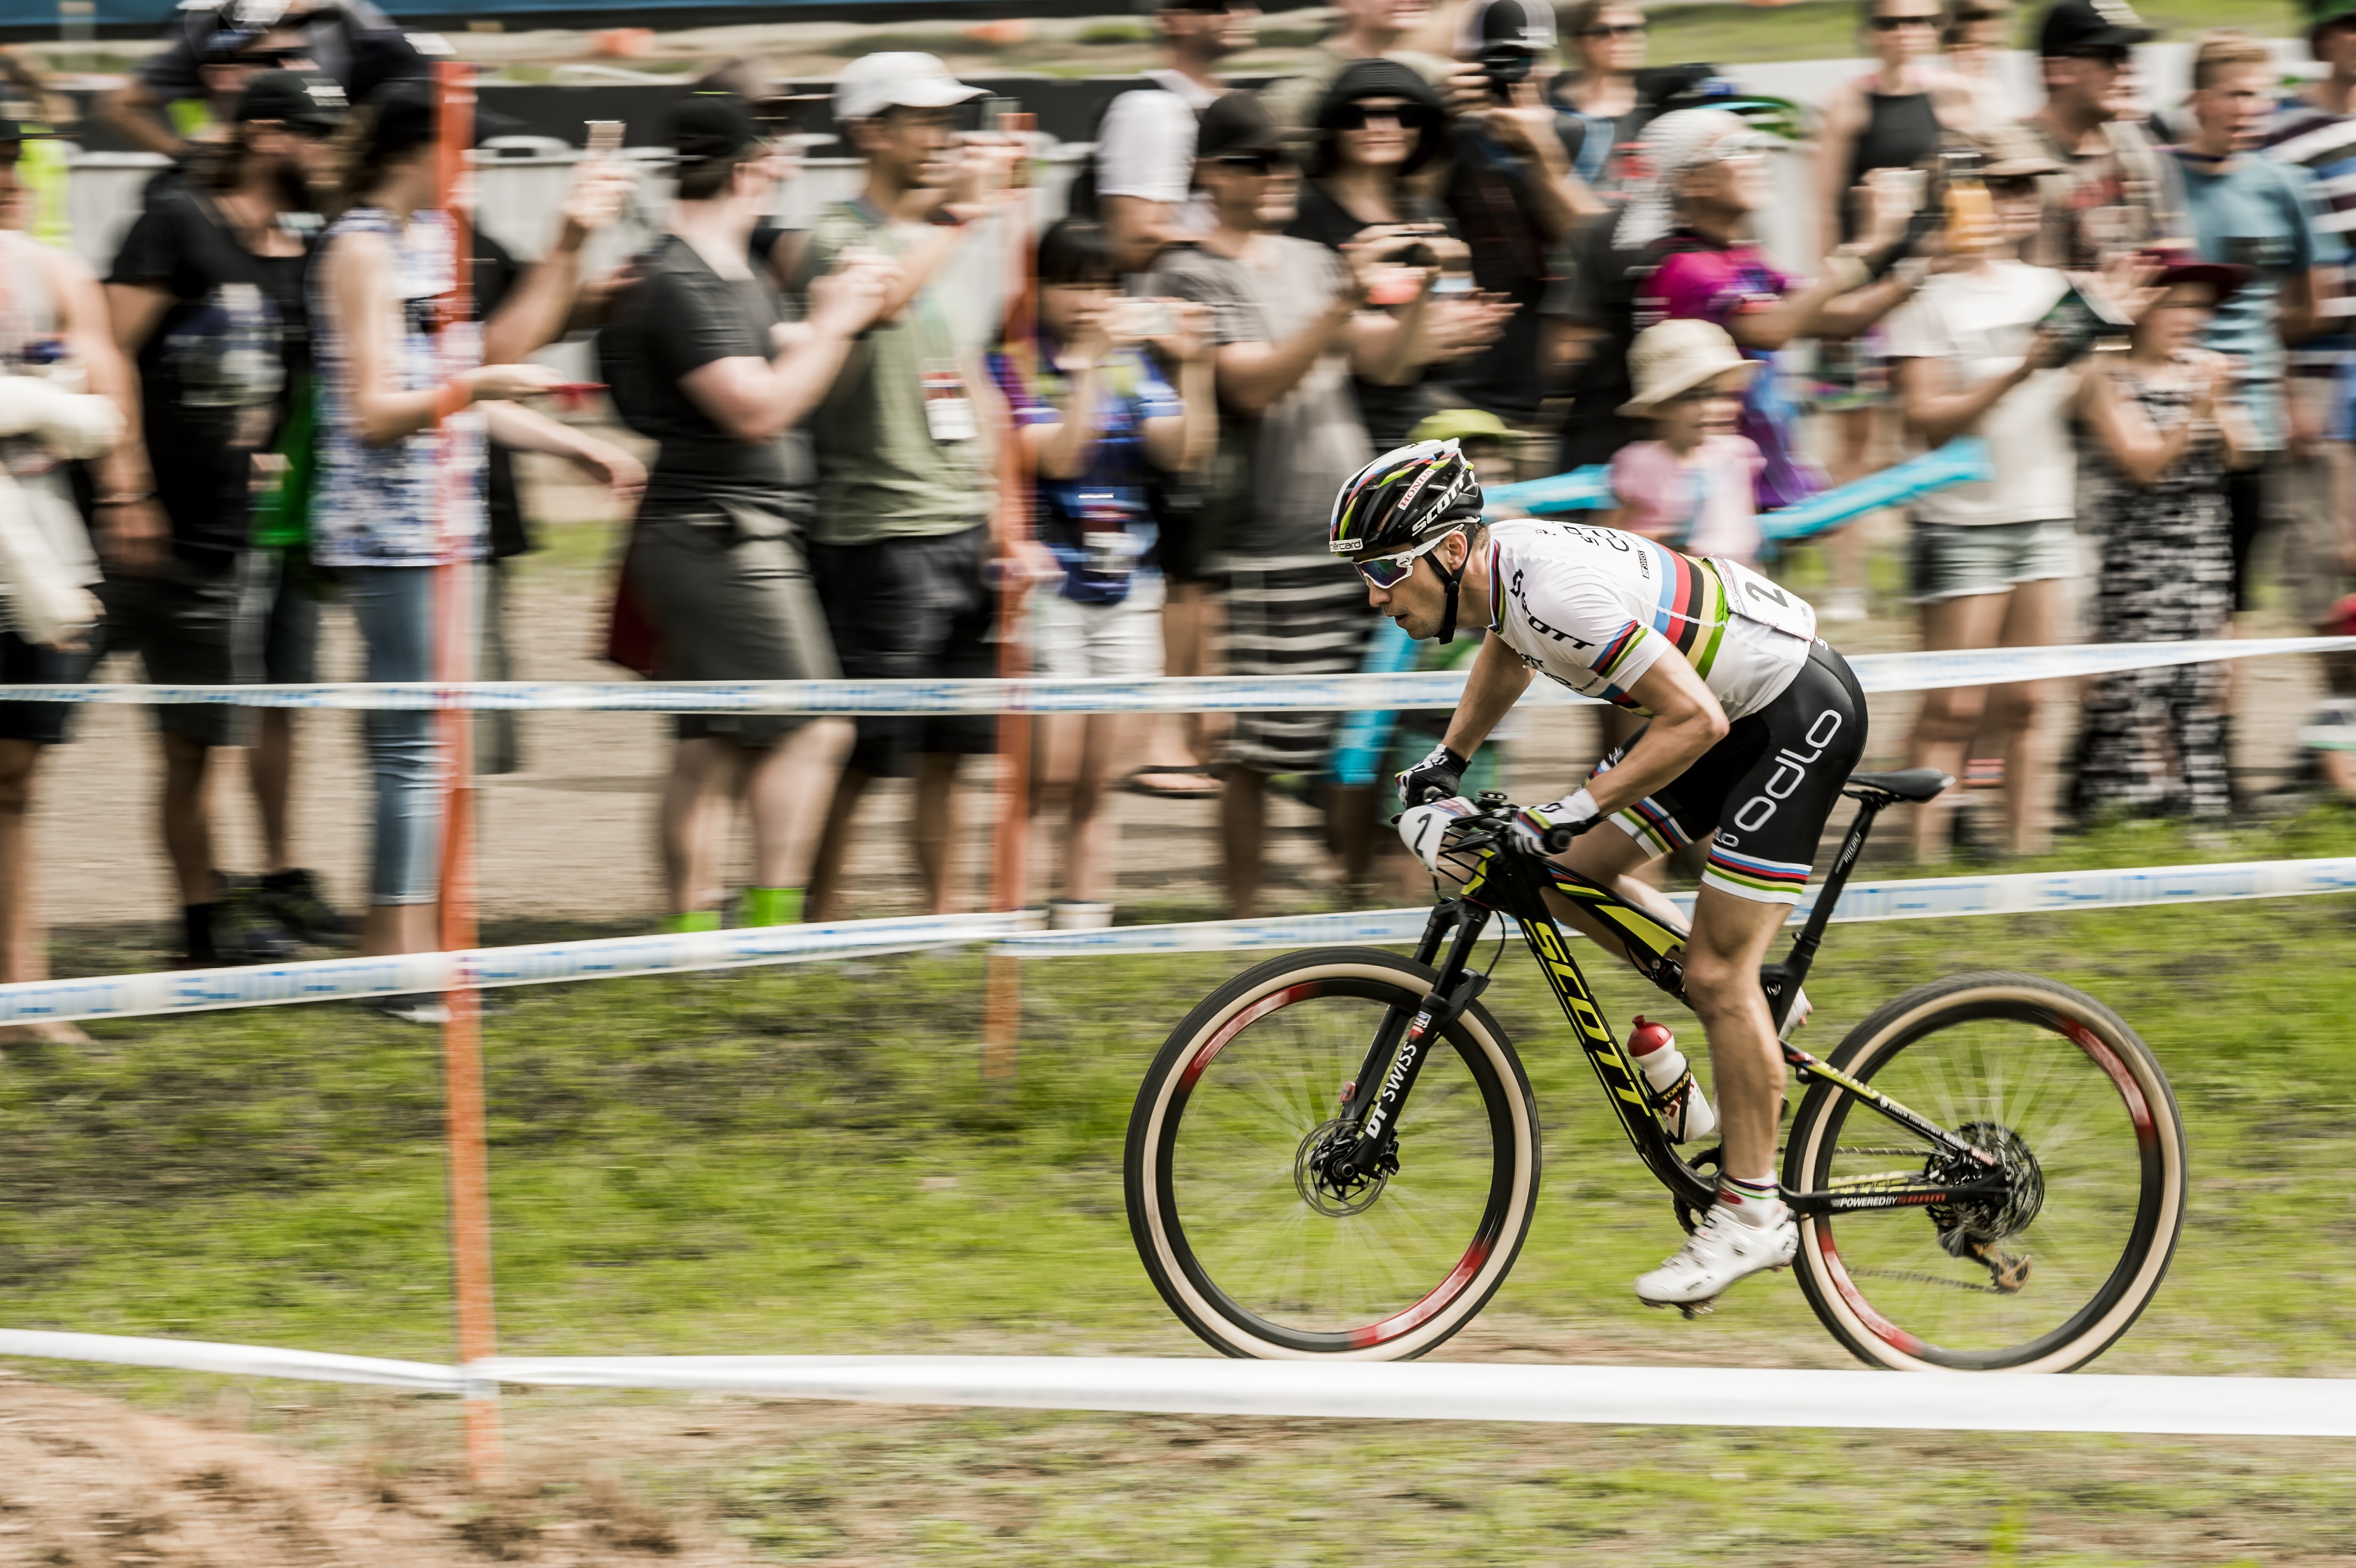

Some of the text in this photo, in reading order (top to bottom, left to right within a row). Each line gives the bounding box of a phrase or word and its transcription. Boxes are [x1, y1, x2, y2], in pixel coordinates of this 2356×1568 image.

[1400, 469, 1433, 508] HONDA
[1412, 473, 1465, 537] SCOTT
[1520, 591, 1596, 650] SCOTT
[1745, 581, 1789, 608] 2
[1734, 709, 1842, 832] odlo
[1413, 813, 1432, 858] 2
[1523, 918, 1651, 1117] SCOTT
[1365, 1041, 1417, 1139] DT SWISS
[1661, 1070, 1691, 1101] TOPEAK
[1840, 1196, 1886, 1208] POWERED
